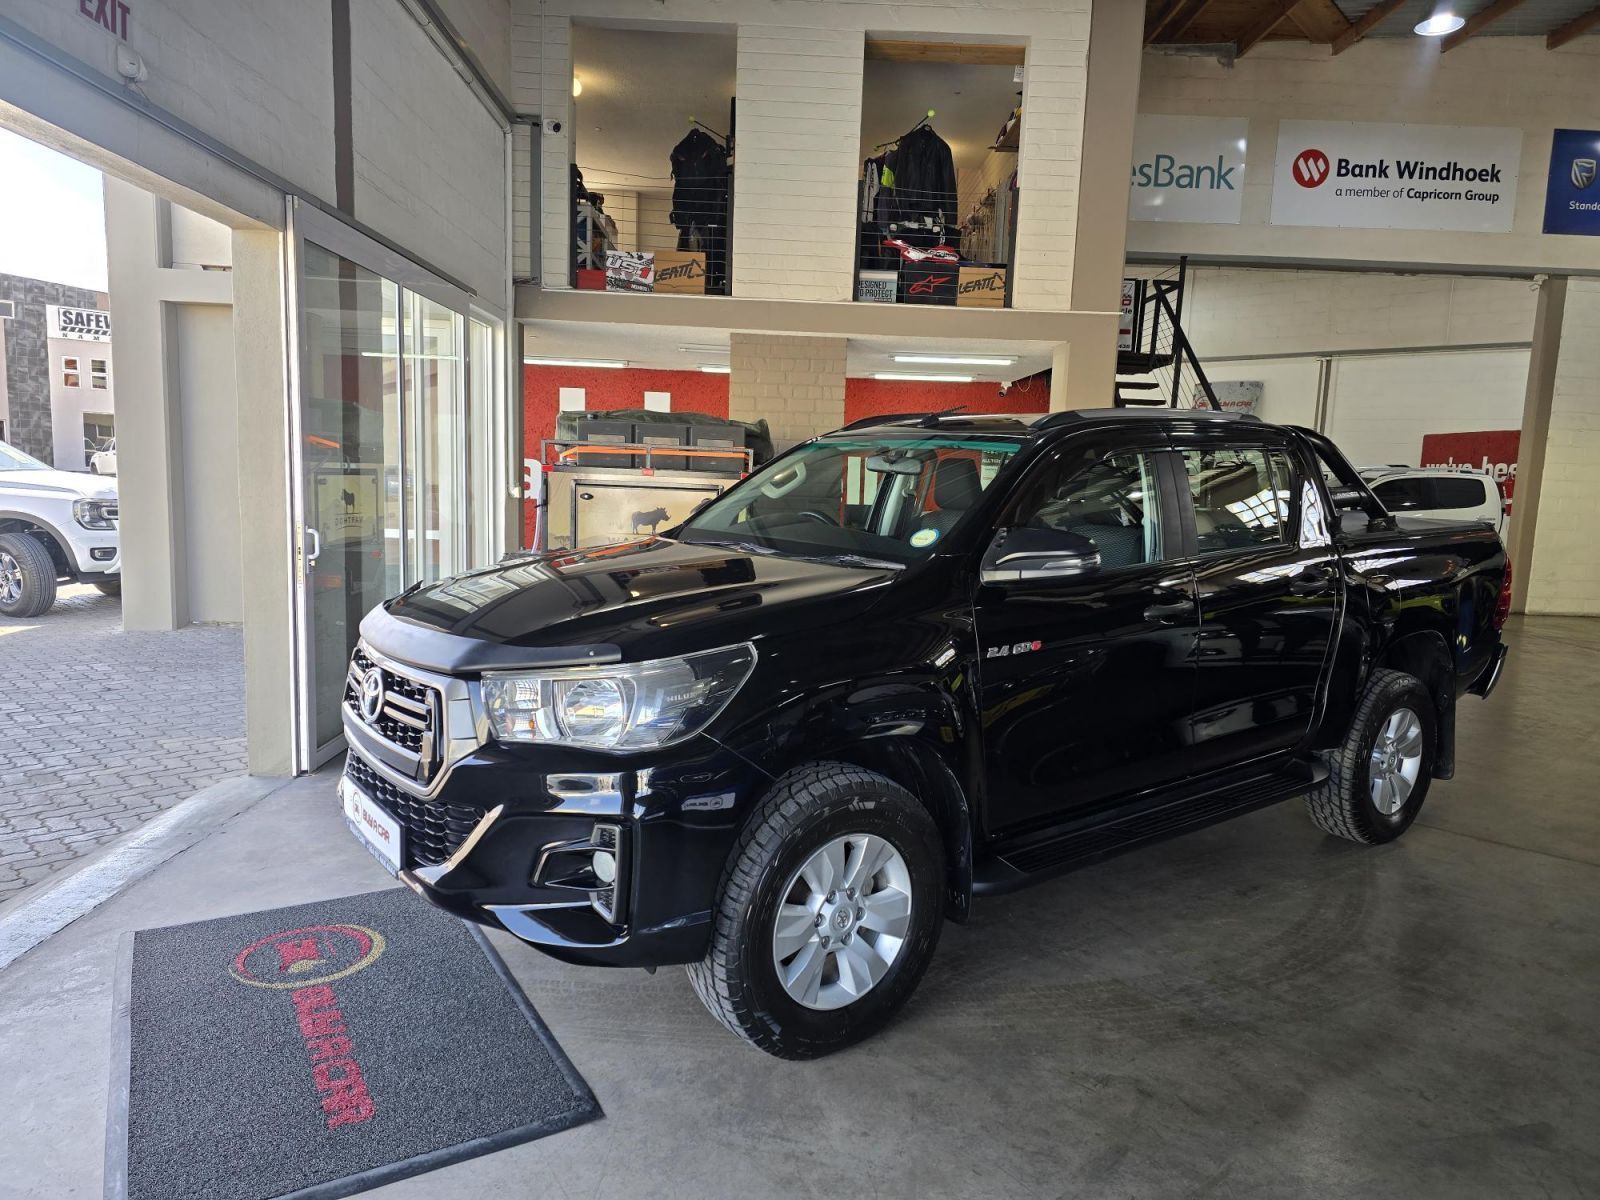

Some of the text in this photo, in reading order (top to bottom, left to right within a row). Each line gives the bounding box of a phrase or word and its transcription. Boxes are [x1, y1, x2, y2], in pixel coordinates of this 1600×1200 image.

[1131, 154, 1235, 190] sBank
[1336, 158, 1502, 183] Bank Windhoek
[1335, 186, 1500, 205] a member of Capricorn Group
[865, 289, 893, 298] PROTECT
